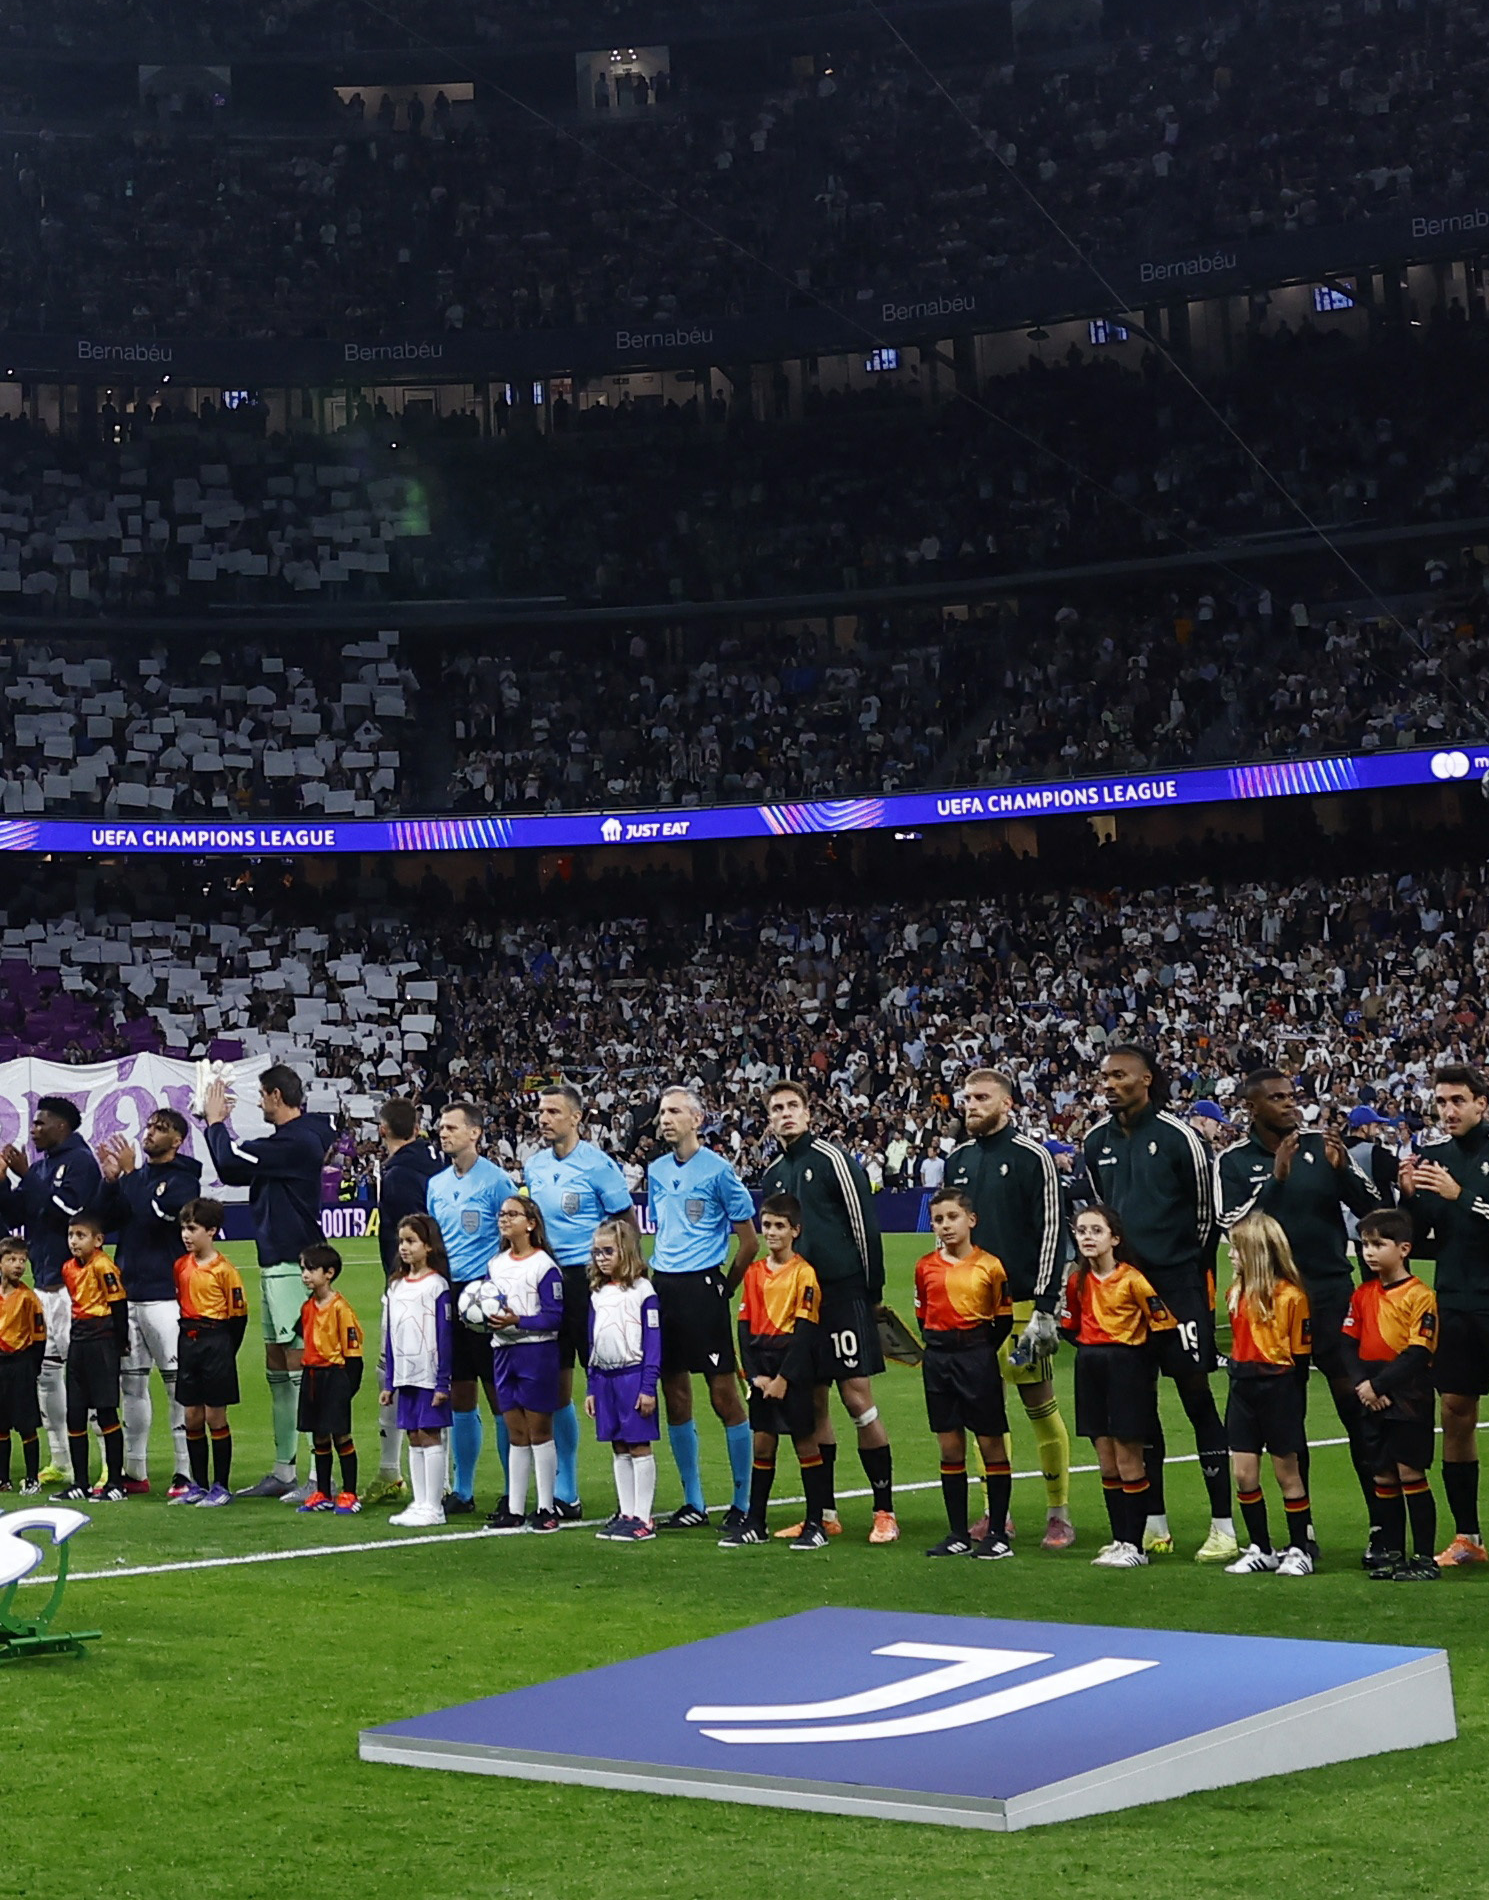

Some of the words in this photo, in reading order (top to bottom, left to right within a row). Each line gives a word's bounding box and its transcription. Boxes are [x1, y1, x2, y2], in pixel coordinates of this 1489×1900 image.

[1140, 251, 1237, 282] Bernabéu
[882, 293, 976, 322] Bernabéu
[78, 340, 173, 363] Bernabéu
[344, 341, 443, 363] Bernabéu
[616, 326, 713, 350] Bernabéu
[937, 798, 984, 816] UEFA
[987, 787, 1099, 812] CHAMPIONS
[1103, 780, 1178, 803] LEAGUE
[92, 829, 138, 846] UEFA
[142, 830, 256, 847] CHAMPIONS
[260, 829, 336, 846] LEAGUE
[625, 824, 660, 840] JUST
[662, 822, 690, 836] EAT
[321, 1208, 380, 1238] OOTBA
[830, 1330, 858, 1359] 10
[1177, 1320, 1199, 1351] 19
